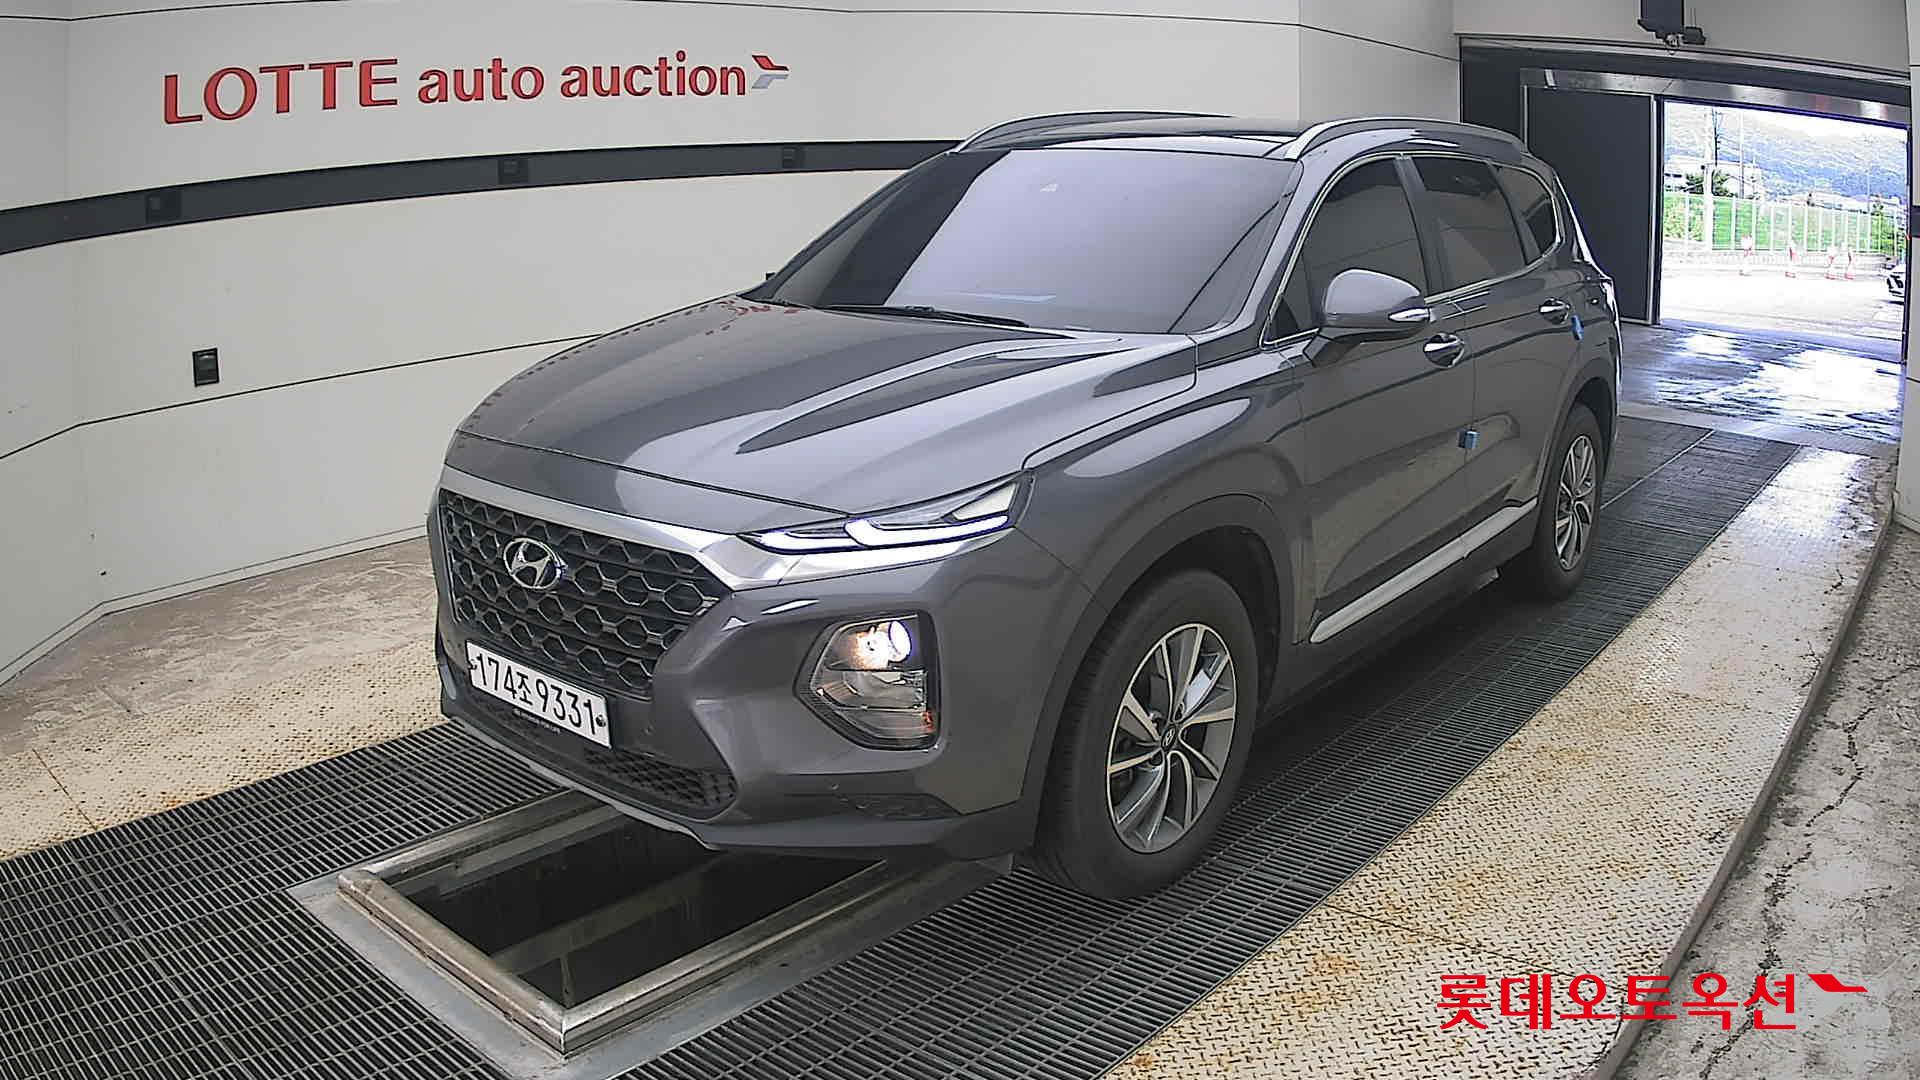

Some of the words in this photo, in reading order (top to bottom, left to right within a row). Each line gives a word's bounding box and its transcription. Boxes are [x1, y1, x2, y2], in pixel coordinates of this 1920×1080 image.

[163, 57, 398, 125] LOTTE
[418, 57, 545, 104] auto
[560, 50, 747, 98] auction
